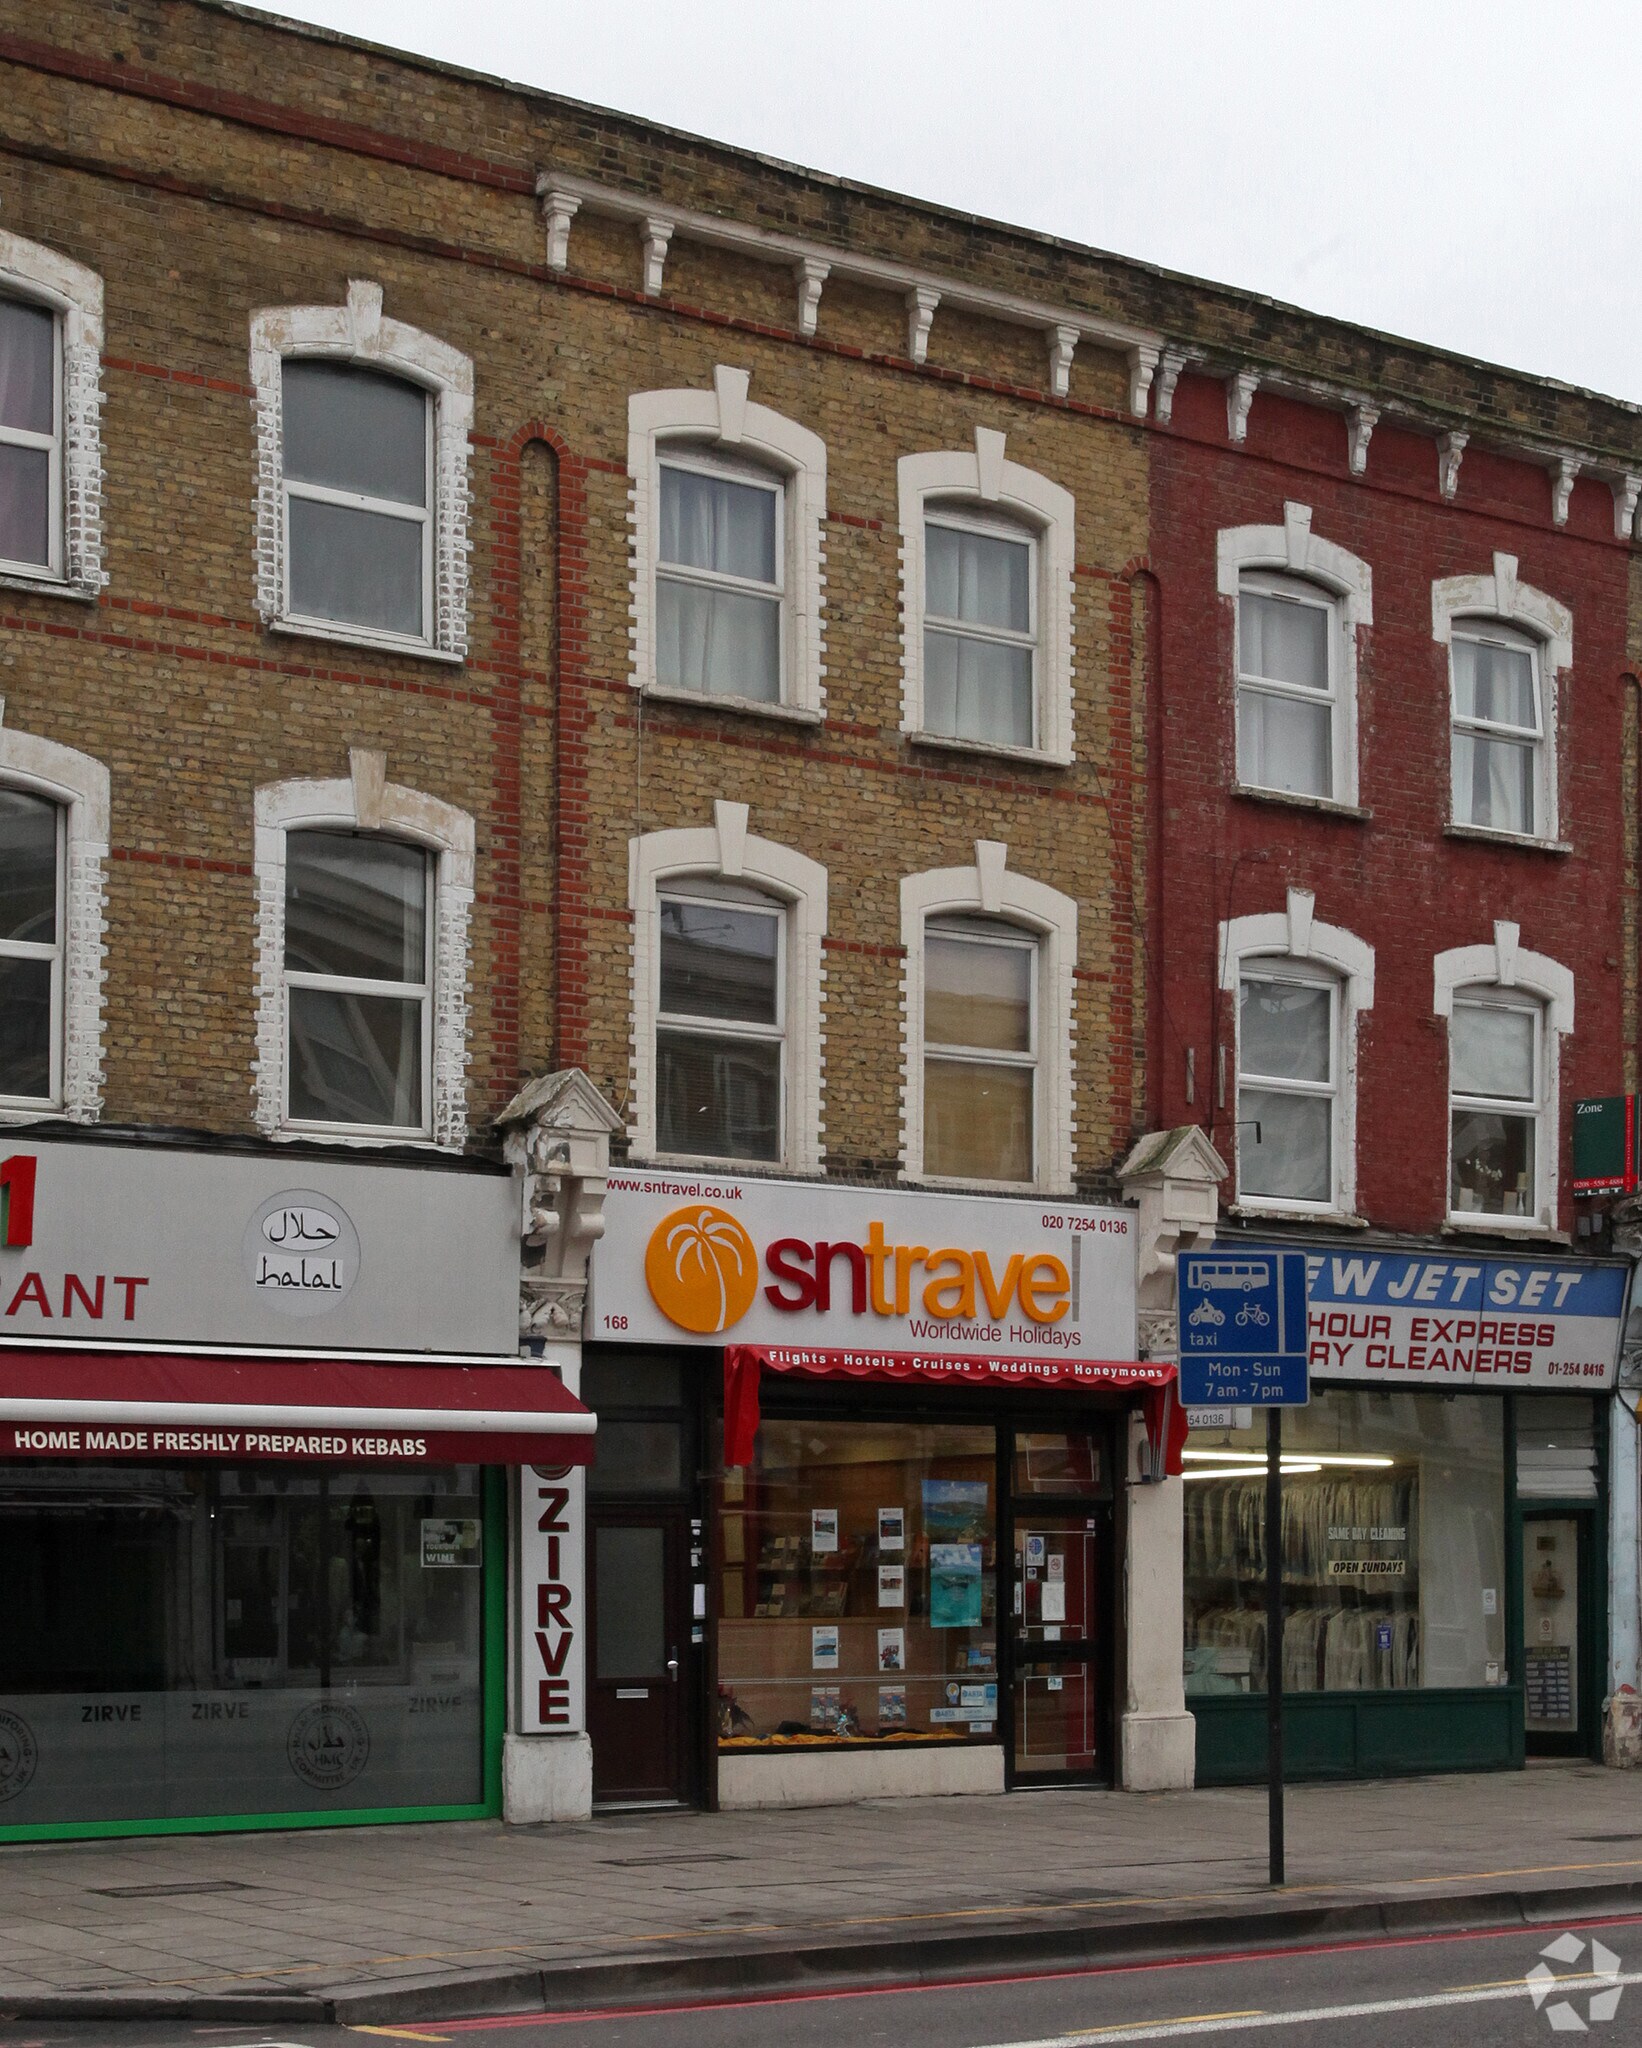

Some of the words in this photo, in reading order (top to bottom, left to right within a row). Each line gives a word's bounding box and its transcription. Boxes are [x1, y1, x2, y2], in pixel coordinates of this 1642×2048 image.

[1577, 1103, 1603, 1115] Zone
[606, 1179, 742, 1200] www.sntravel.co.uk
[269, 1211, 337, 1243] حلال
[1042, 1215, 1063, 1229] 020
[1067, 1217, 1096, 1232] 7254
[1100, 1220, 1128, 1235] 0136
[256, 1255, 342, 1290] halal
[1387, 1263, 1482, 1303] JET
[1489, 1269, 1583, 1308] SET
[0, 1272, 149, 1321] ANT
[603, 1314, 629, 1330] 168
[1308, 1311, 1392, 1340] HOUR
[1410, 1317, 1556, 1347] EXPRESS
[910, 1319, 1002, 1342] Worldwide
[1010, 1325, 1081, 1349] Holidays
[1189, 1332, 1218, 1346] taxi
[769, 1351, 827, 1366] Flights
[844, 1354, 895, 1368] Hotels
[912, 1357, 971, 1371] Cruises
[989, 1361, 1059, 1376] Weddings
[1074, 1364, 1163, 1379] Honeymoons
[1308, 1341, 1354, 1367] RY
[1366, 1344, 1532, 1374] CLEANERS
[1208, 1363, 1241, 1377] Mon
[1252, 1362, 1281, 1377] Sun
[1548, 1362, 1580, 1376] 01-254
[1583, 1363, 1605, 1377] 8416
[1202, 1414, 1224, 1425] 0136
[14, 1430, 81, 1450] HOME
[86, 1431, 148, 1450] MADE
[153, 1432, 241, 1452] FRESHLY
[245, 1434, 348, 1454] PREPARED
[352, 1437, 427, 1456] KEBABS
[1328, 1527, 1350, 1540] SAME
[1352, 1527, 1368, 1540] DAY
[1370, 1527, 1406, 1540] CLEANING
[425, 1553, 456, 1564] WINE
[1333, 1562, 1360, 1574] OPEN
[1362, 1561, 1403, 1574] SUNDAYS
[534, 1487, 574, 1725] ZIRVE
[81, 1704, 142, 1723] ZIRVE
[191, 1701, 250, 1720] ZIRVE
[408, 1696, 462, 1714] ZIRVE
